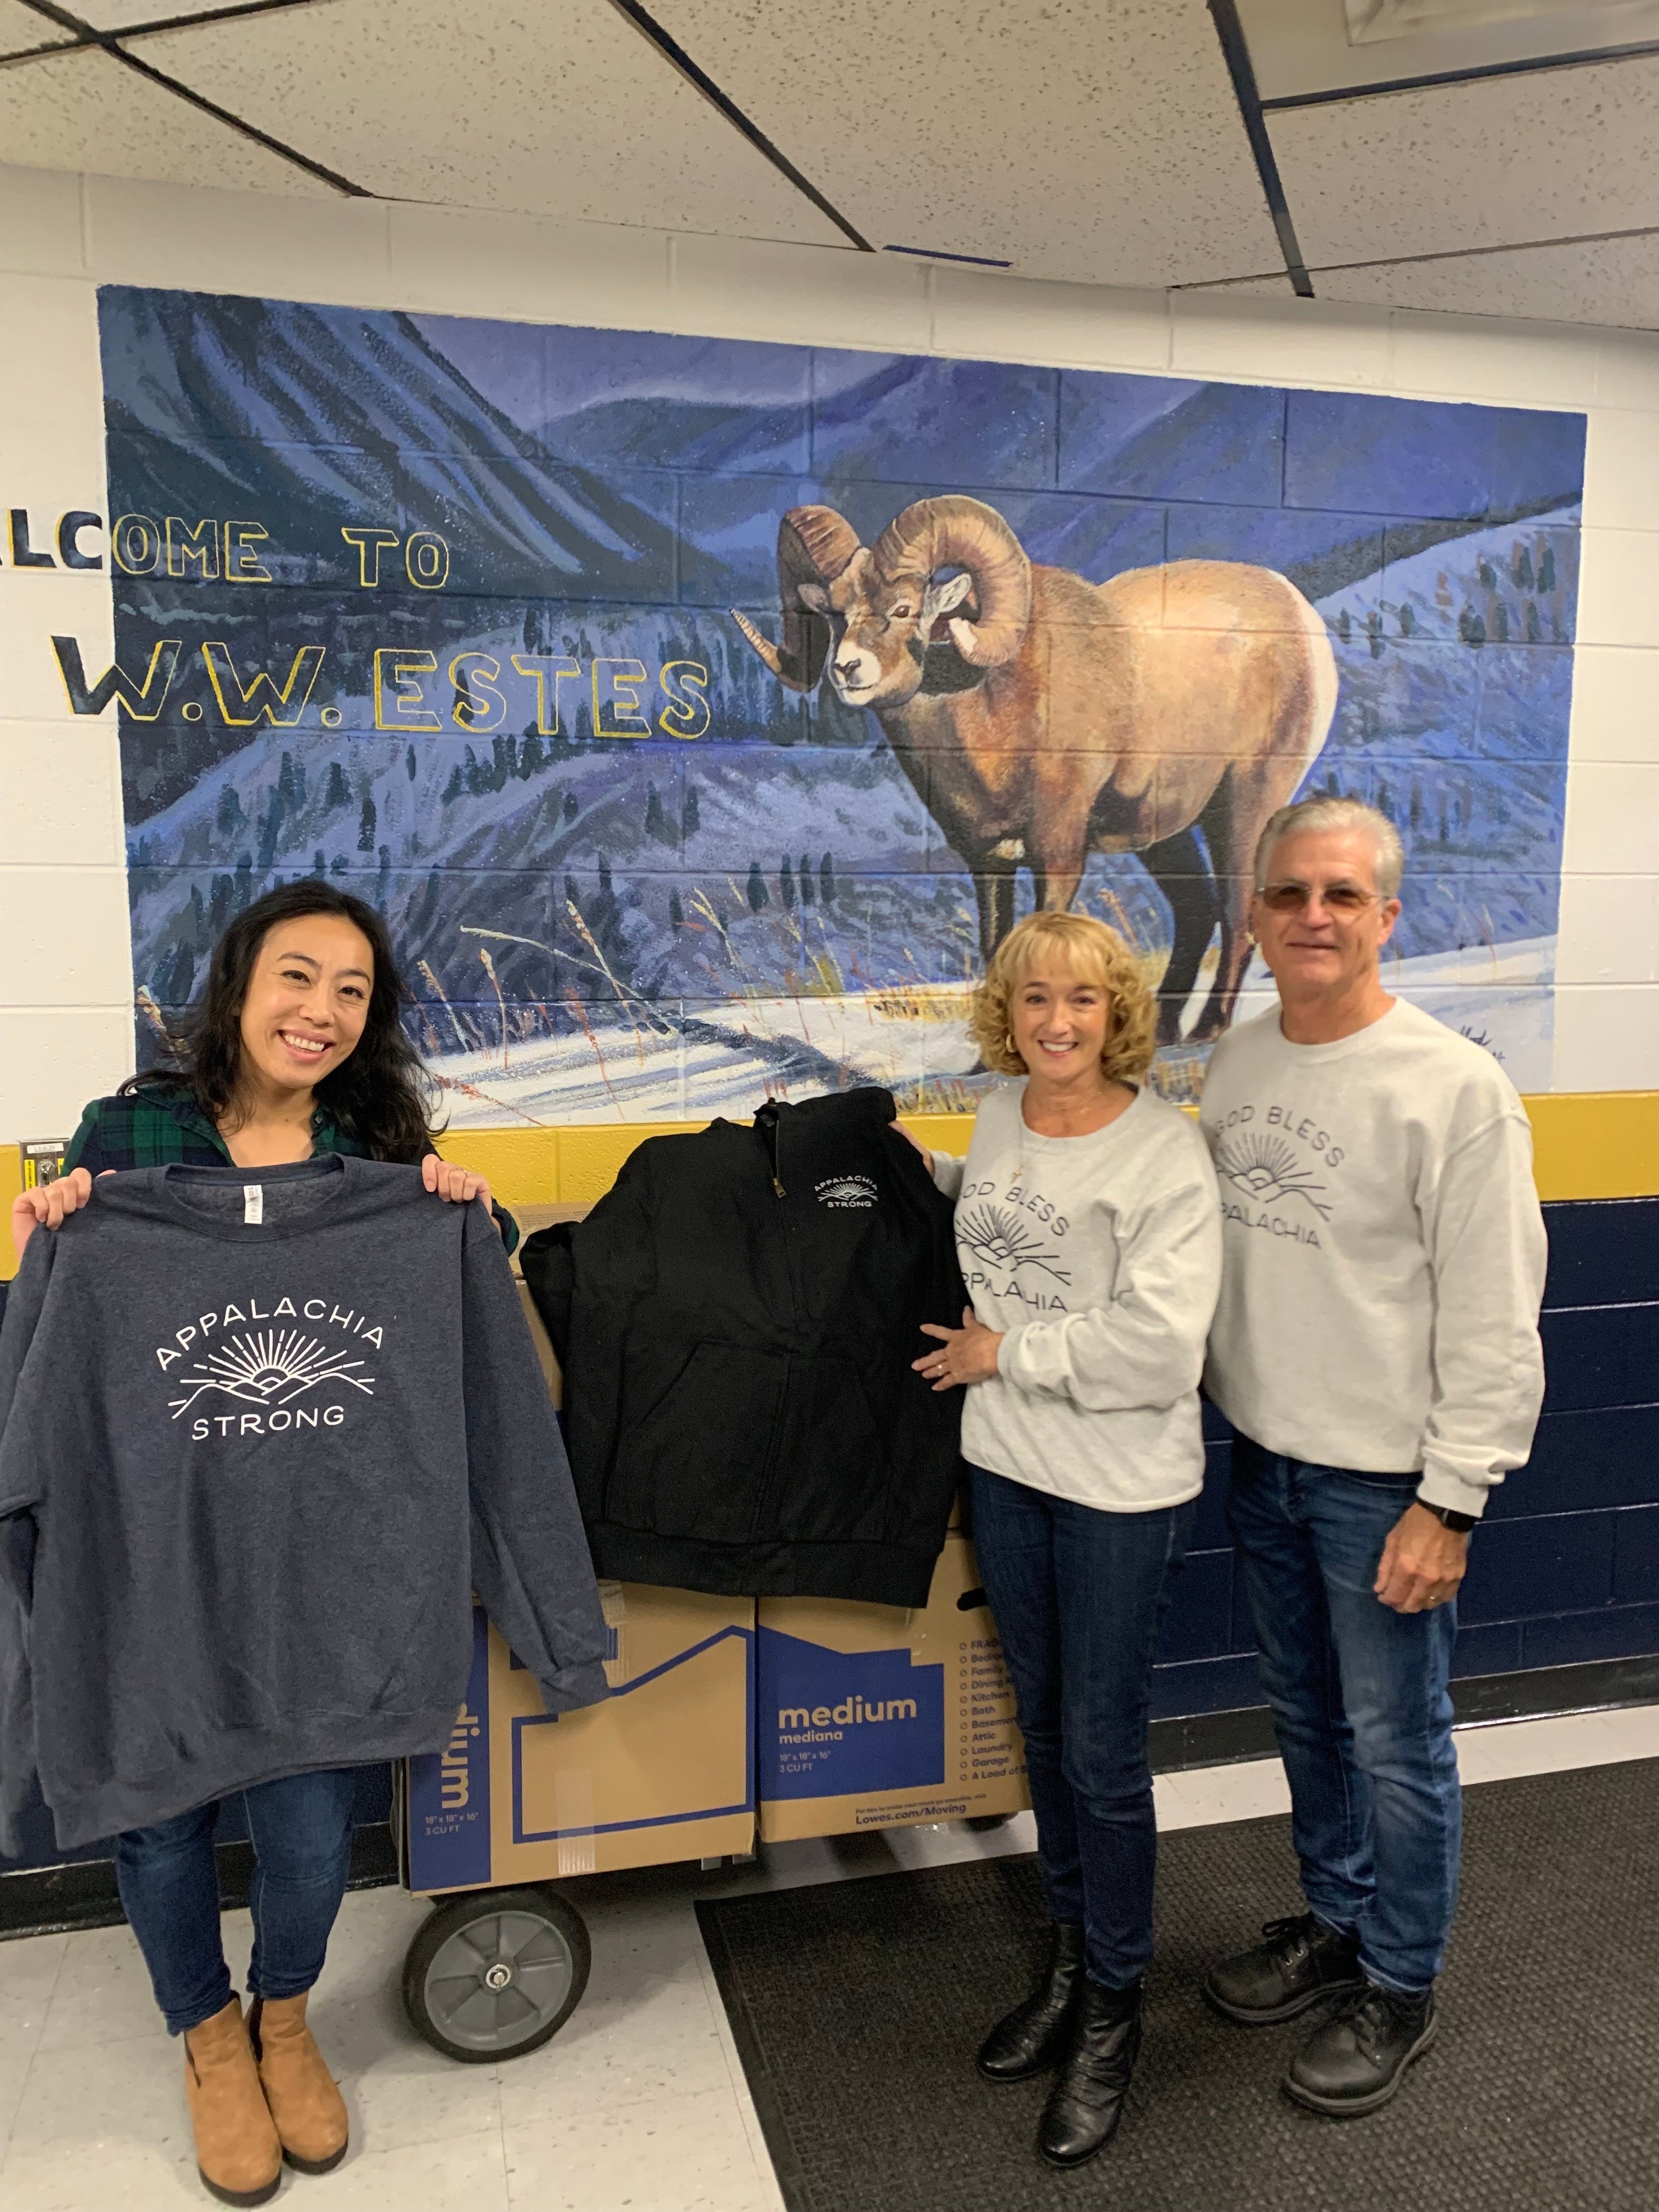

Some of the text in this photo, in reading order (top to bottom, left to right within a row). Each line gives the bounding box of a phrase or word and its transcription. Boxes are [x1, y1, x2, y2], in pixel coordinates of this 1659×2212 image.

[0, 509, 449, 589] LCOME TO
[50, 634, 710, 740] W.W. ESTES
[1267, 1105, 1345, 1167] BLESS
[814, 1175, 878, 1192] APPALACHIA
[961, 1182, 1070, 1237] OD BLESS
[156, 1296, 383, 1370] APPALACHIA
[191, 1405, 345, 1440] STRONG
[778, 1695, 917, 1729] medium
[778, 1729, 843, 1745] mediana
[787, 1764, 800, 1773] CU
[803, 1763, 814, 1771] FT
[972, 1757, 1009, 1767] Garage
[432, 1825, 447, 1835] CU
[449, 1824, 460, 1833] FT
[855, 1804, 967, 1825] Lowes.com/Moving
